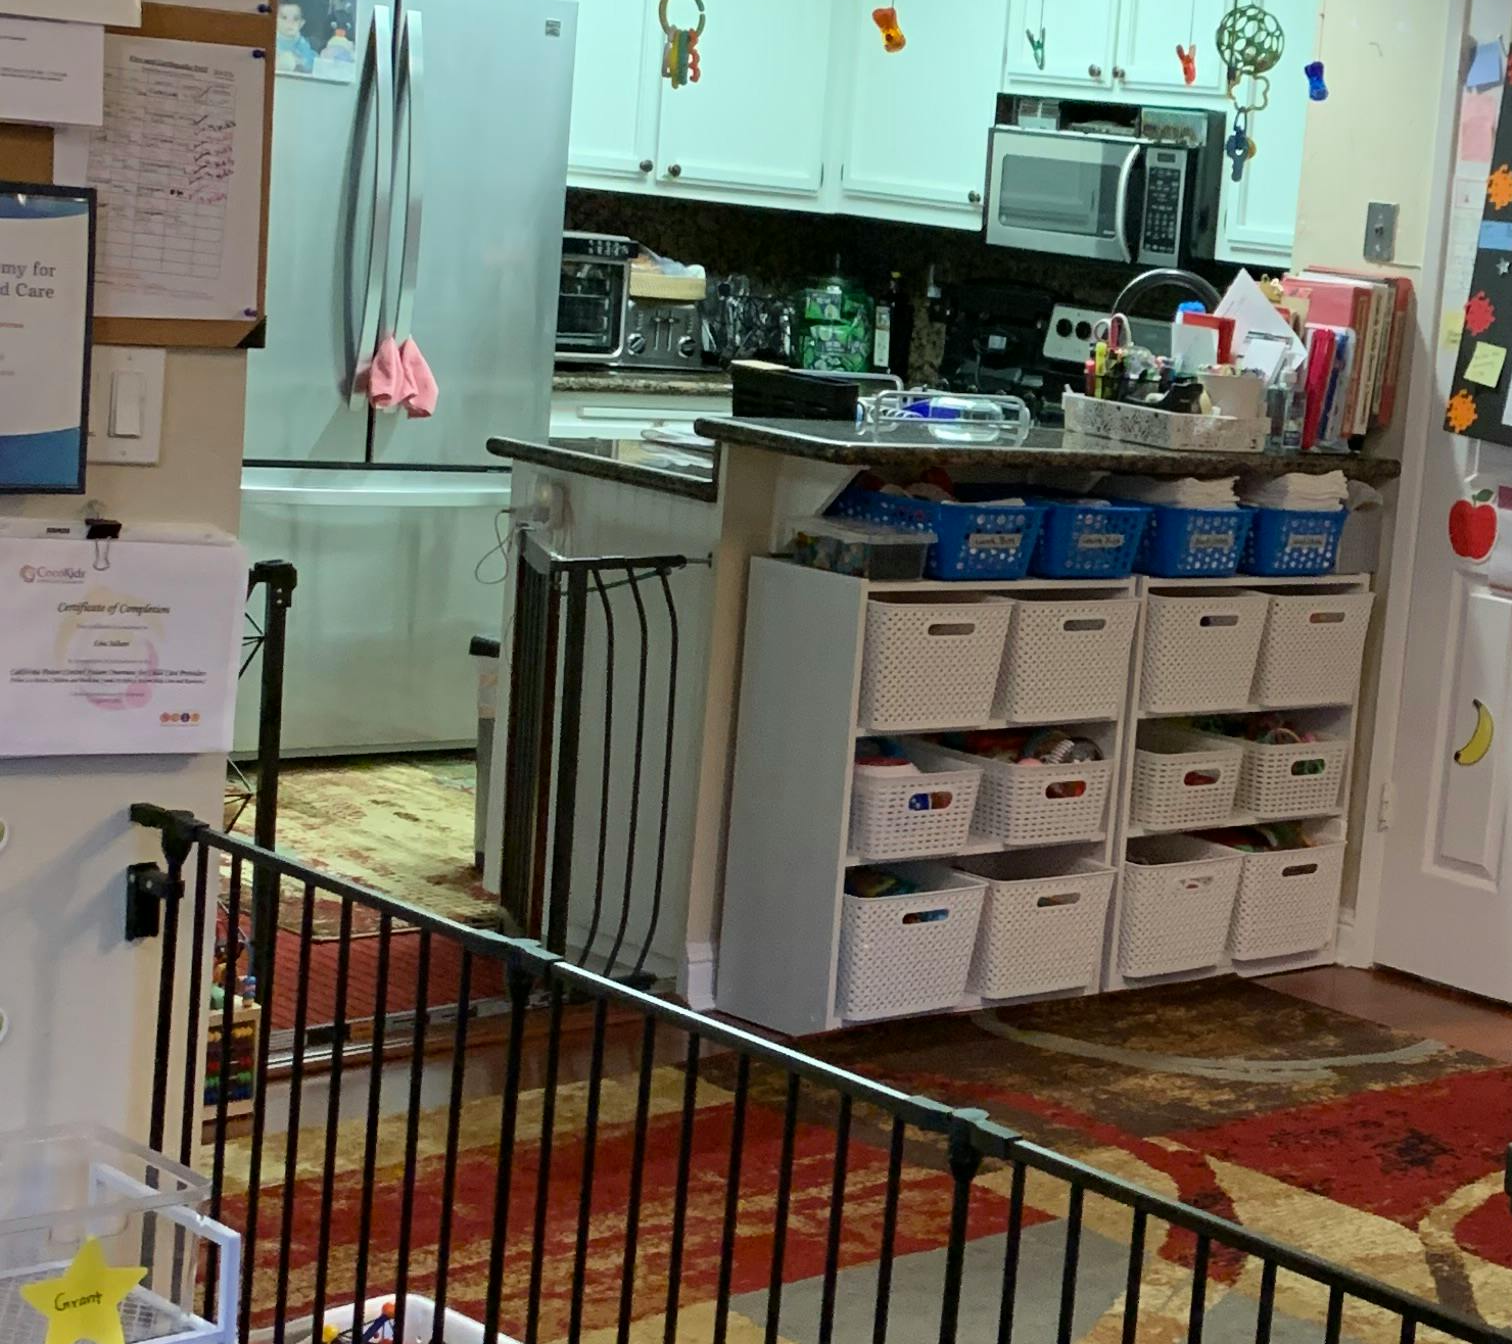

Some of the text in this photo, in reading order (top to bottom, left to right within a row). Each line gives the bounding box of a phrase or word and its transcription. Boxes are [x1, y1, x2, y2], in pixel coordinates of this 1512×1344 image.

[33, 261, 56, 277] for
[15, 282, 55, 298] Care
[54, 1290, 104, 1312] Grant
